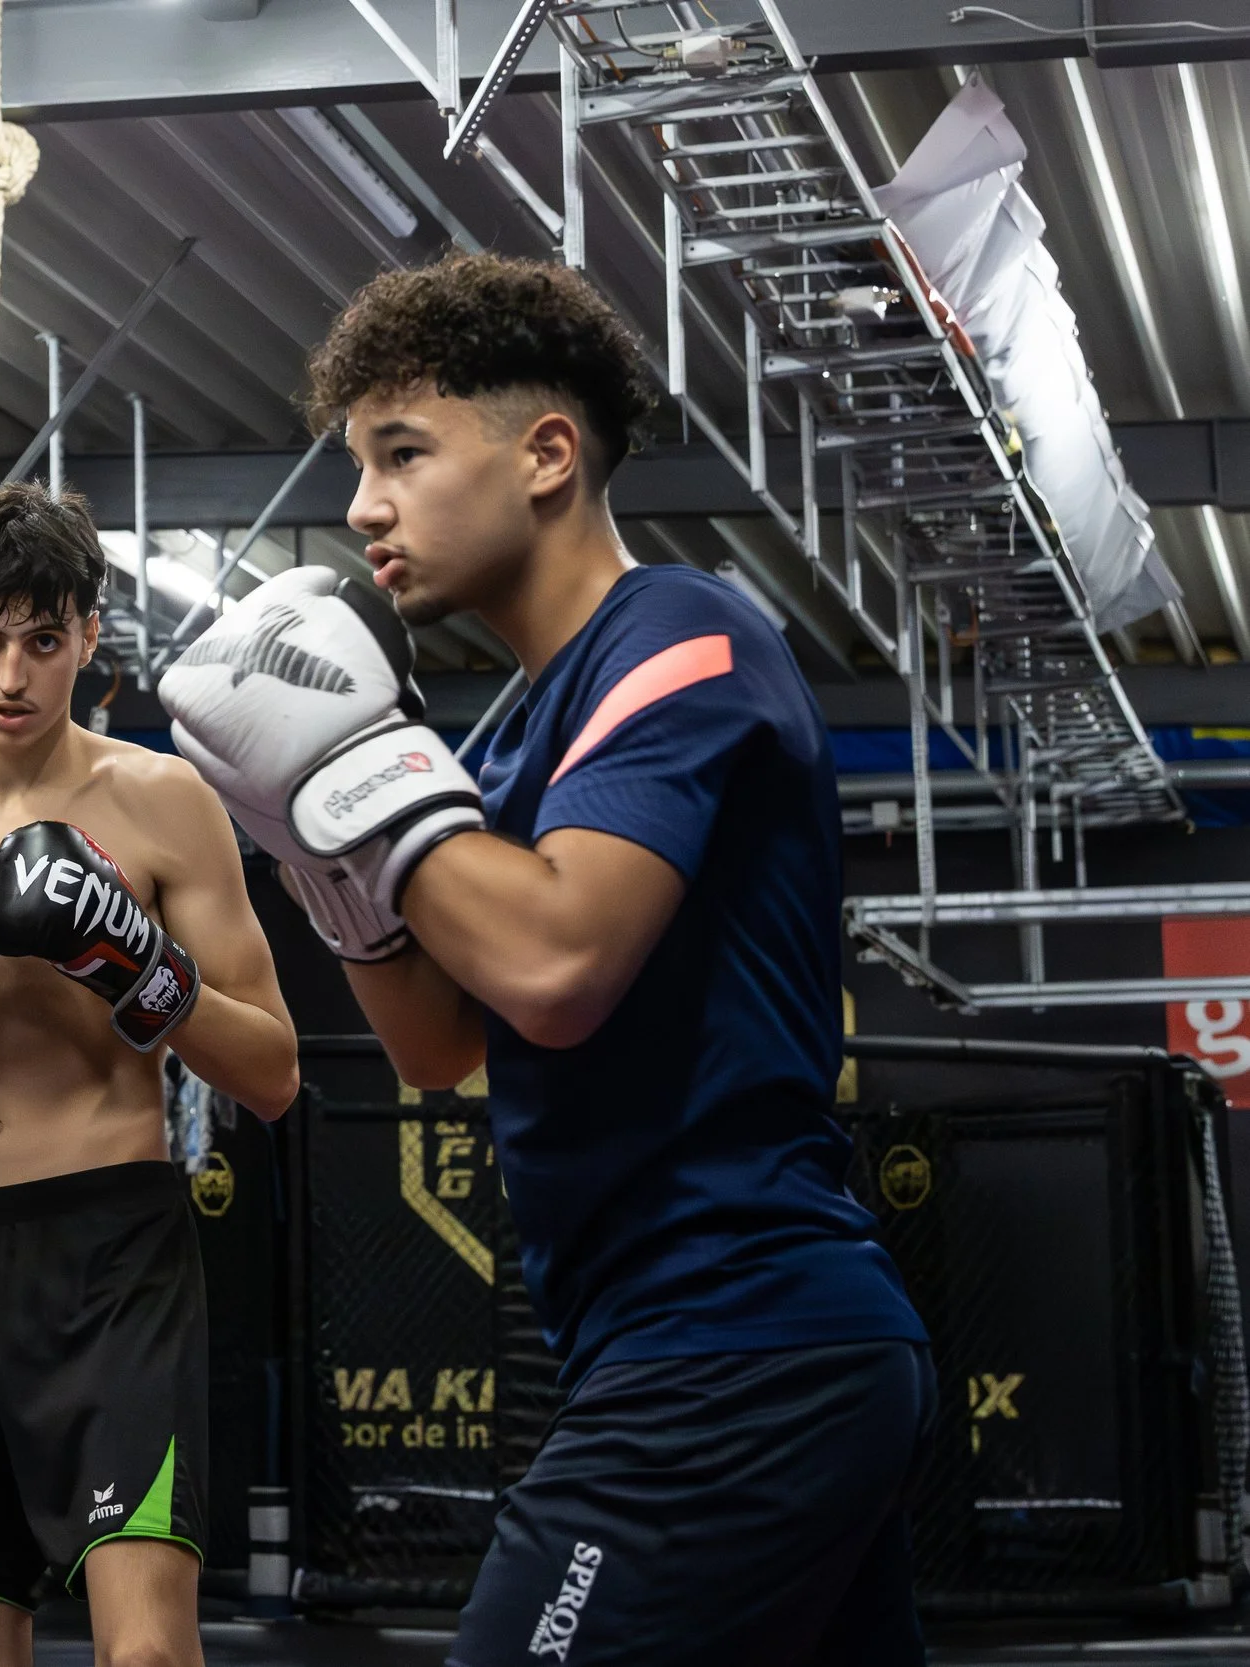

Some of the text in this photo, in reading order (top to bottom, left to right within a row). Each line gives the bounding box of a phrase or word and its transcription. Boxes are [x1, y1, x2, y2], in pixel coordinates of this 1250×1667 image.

[14, 852, 150, 955] VENUM
[401, 1414, 447, 1450] de
[88, 1503, 124, 1524] erima
[536, 1540, 604, 1664] SPROX
